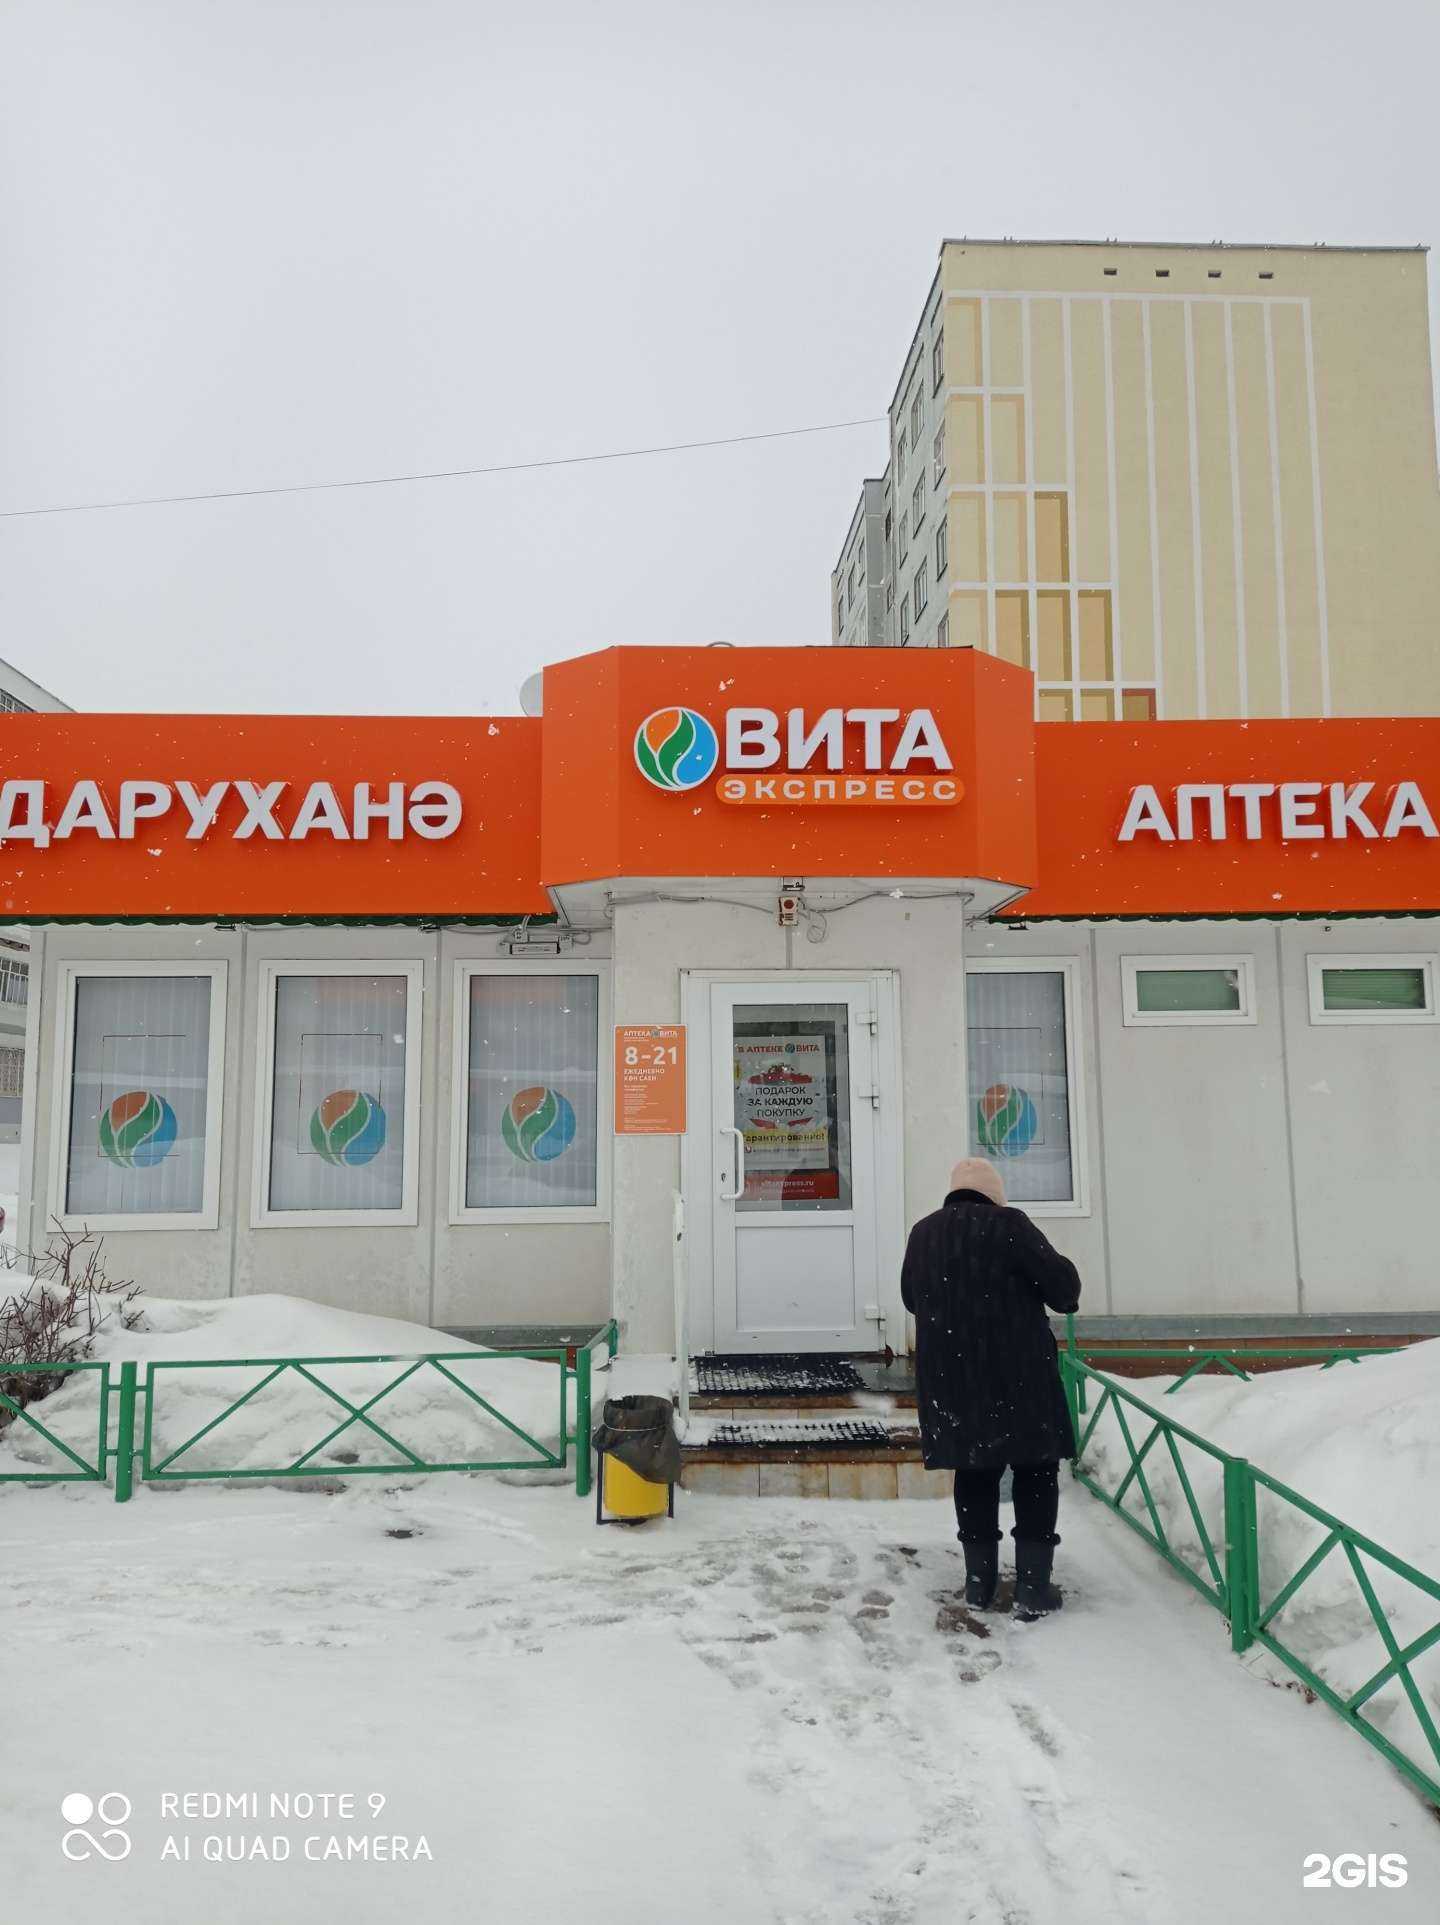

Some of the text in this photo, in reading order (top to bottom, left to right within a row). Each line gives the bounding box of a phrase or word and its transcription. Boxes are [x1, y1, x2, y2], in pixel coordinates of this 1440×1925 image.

[725, 707, 954, 771] ВИТА
[723, 779, 957, 800] ЭКСПРЕСС
[0, 779, 463, 848] ДАРУХАНӘ
[1117, 781, 1440, 841] АПТЕКА
[796, 1044, 820, 1053] ВИТА
[755, 1086, 806, 1096] ПОДАРОК
[748, 1097, 814, 1107] ЗА КАЖДУЮ
[756, 1108, 806, 1118] ПОКУПКУ
